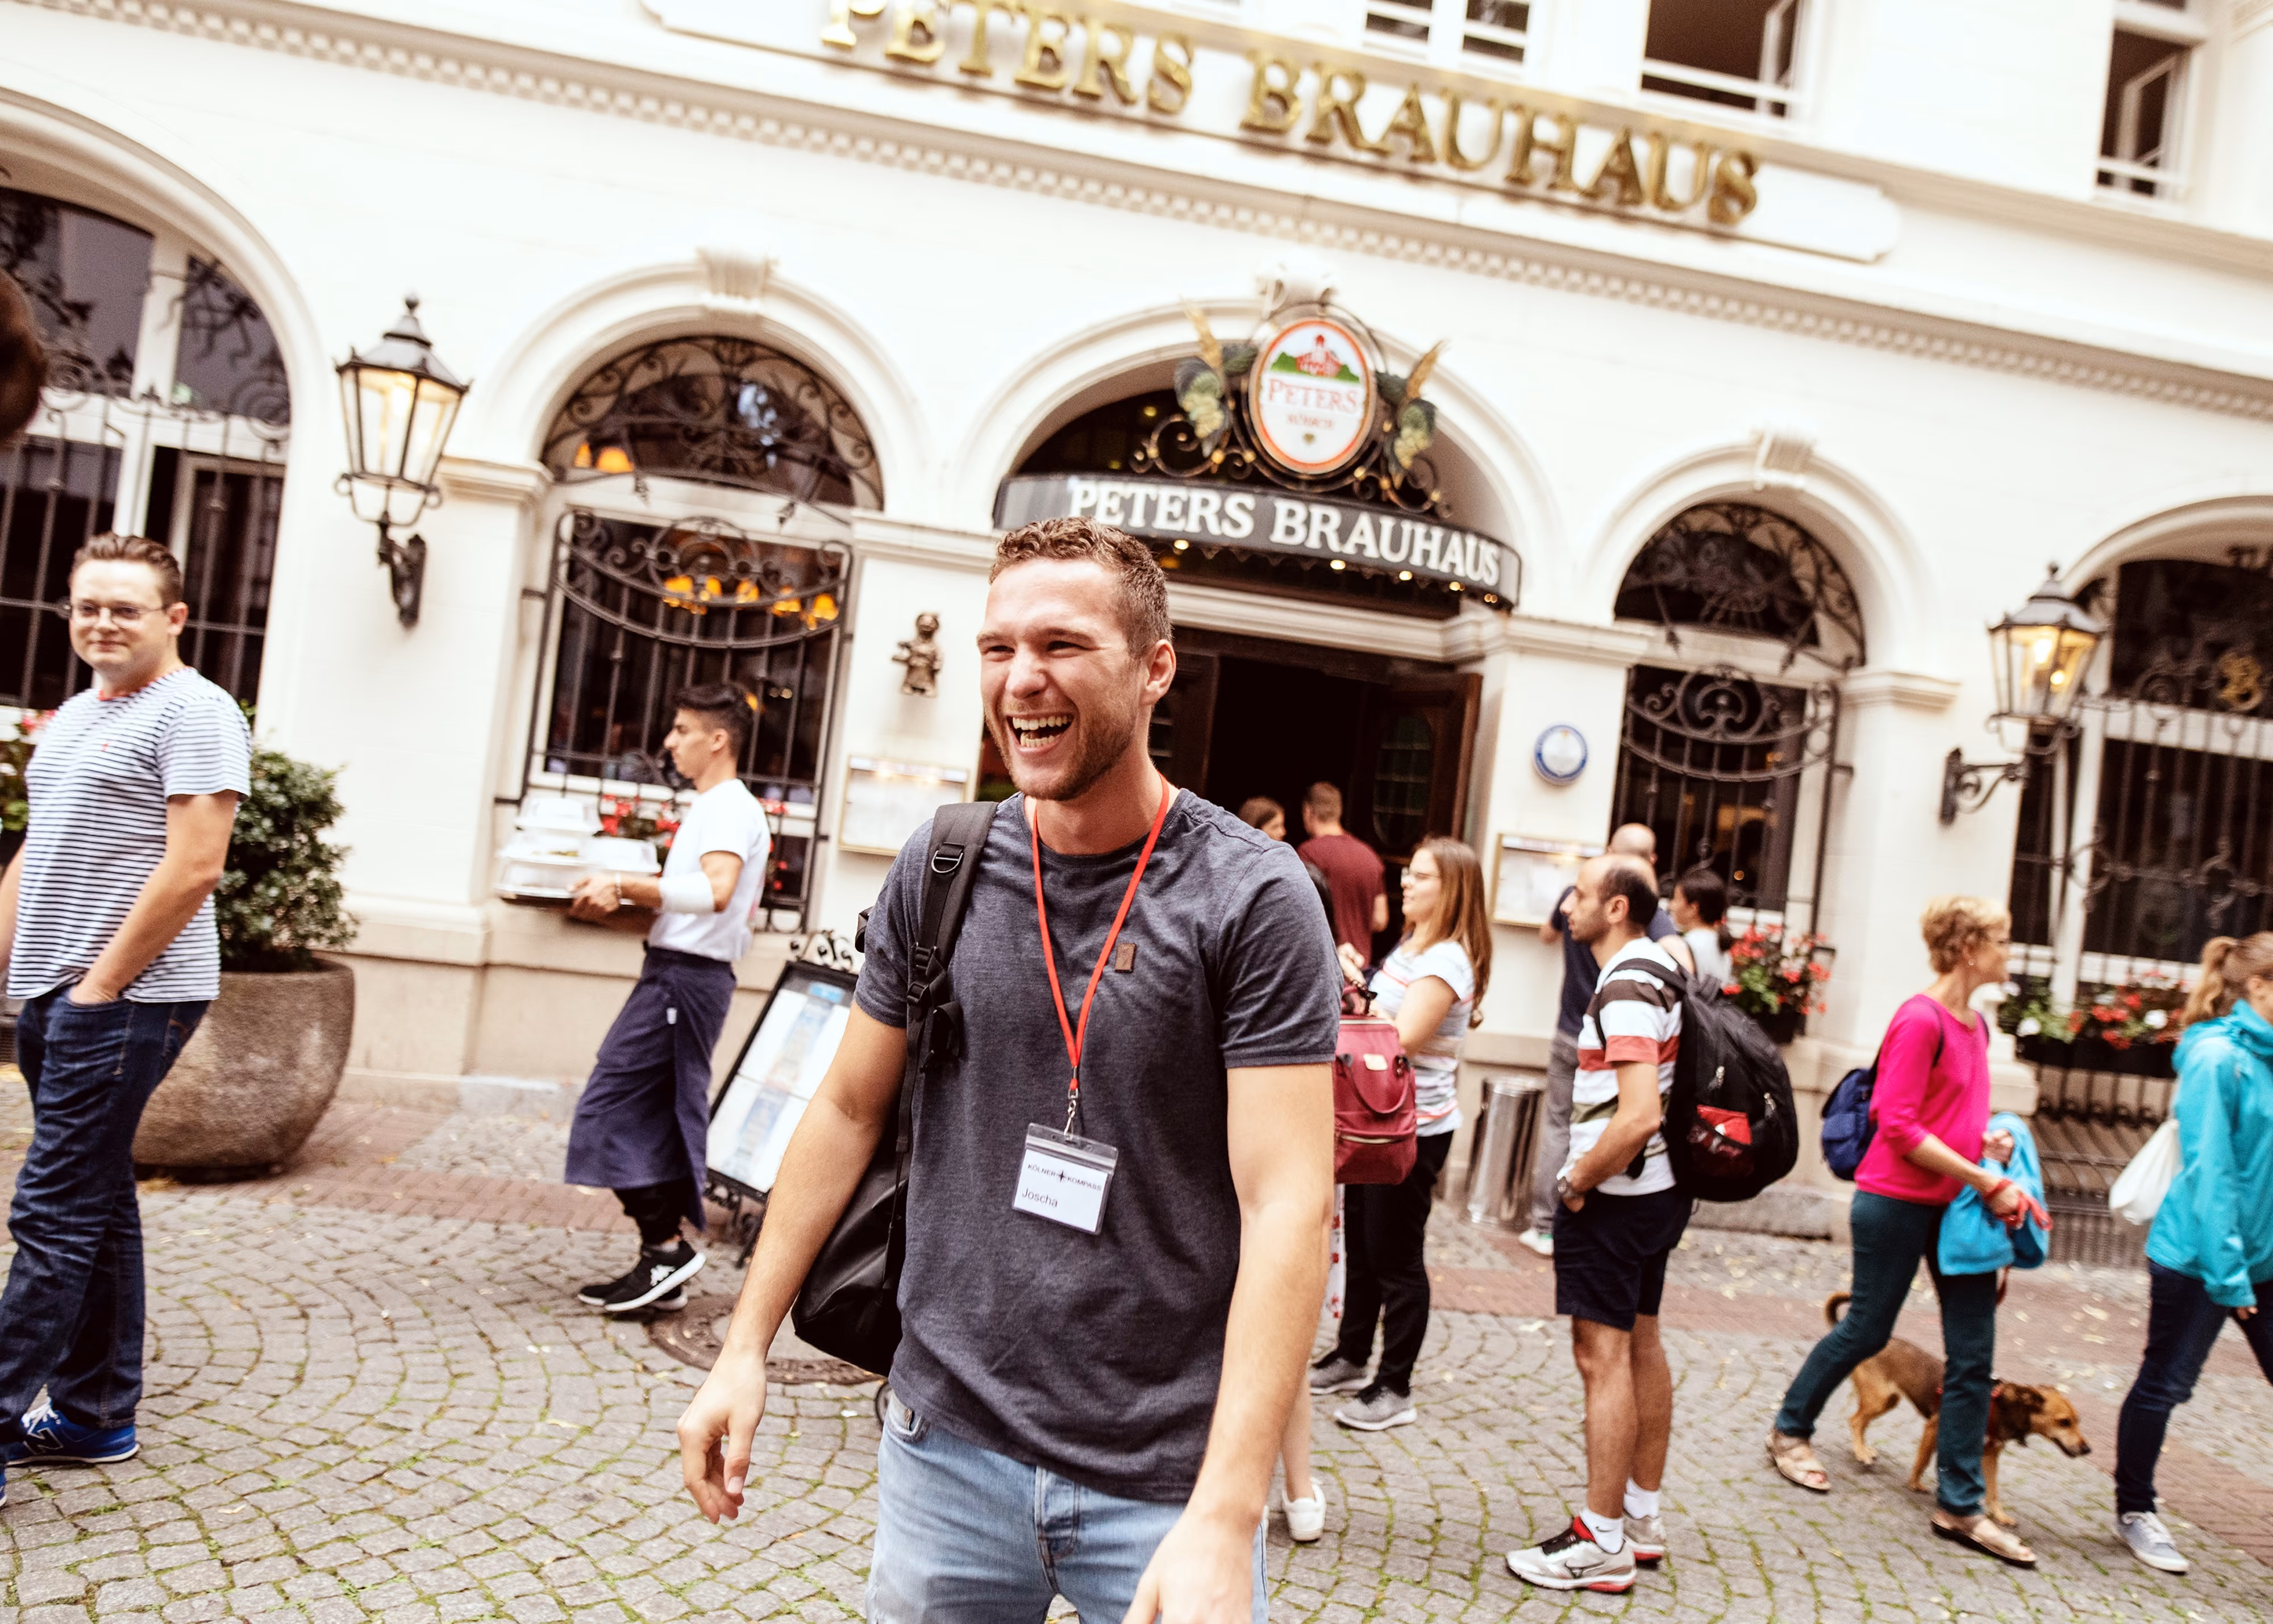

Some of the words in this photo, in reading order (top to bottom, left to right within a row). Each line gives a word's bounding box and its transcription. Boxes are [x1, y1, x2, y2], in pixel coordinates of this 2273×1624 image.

[820, 0, 1194, 114] PETERS
[1239, 48, 1758, 225] BRAUHAUS
[1268, 378, 1360, 414] PETERS
[1068, 480, 1256, 539] PETERS
[1269, 499, 1500, 586] BRAUHAUS
[1022, 1188, 1058, 1207] Joscha
